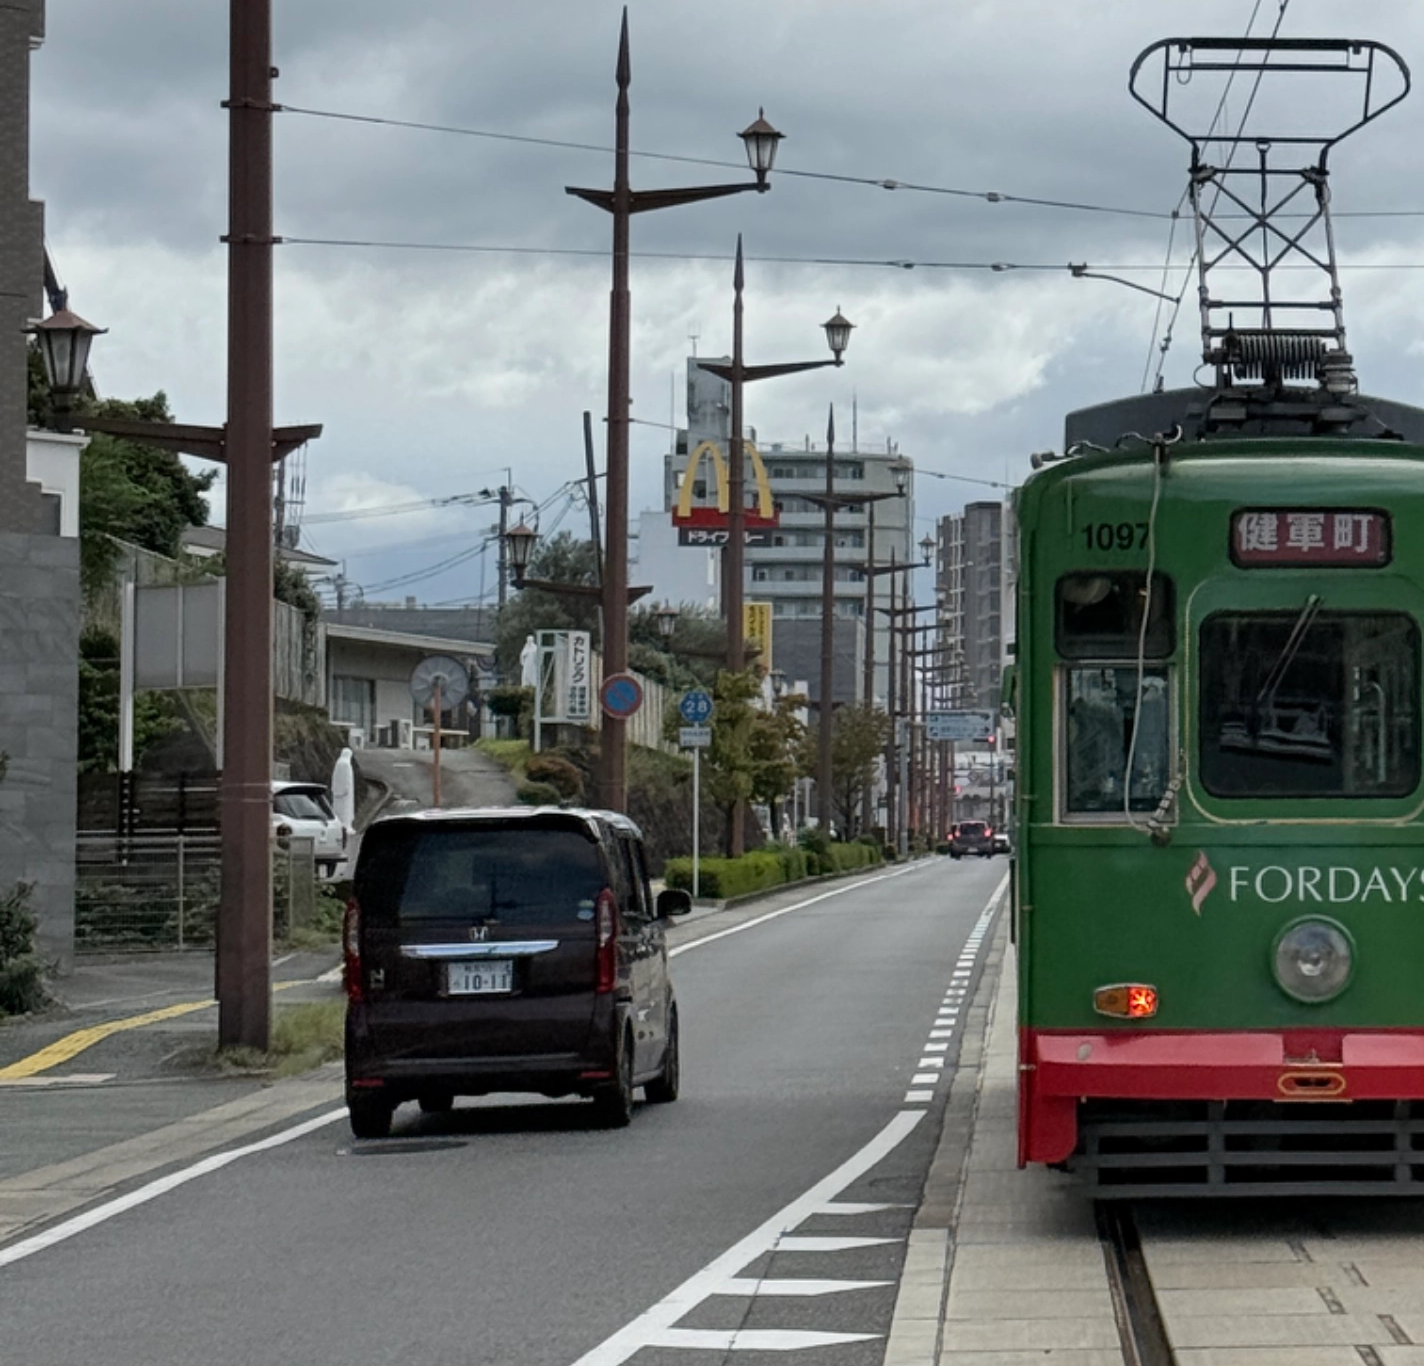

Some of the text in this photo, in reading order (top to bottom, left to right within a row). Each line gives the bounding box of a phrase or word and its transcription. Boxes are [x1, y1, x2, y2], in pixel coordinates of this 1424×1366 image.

[1081, 523, 1149, 551] 1097
[1237, 512, 1374, 553] 健軍町
